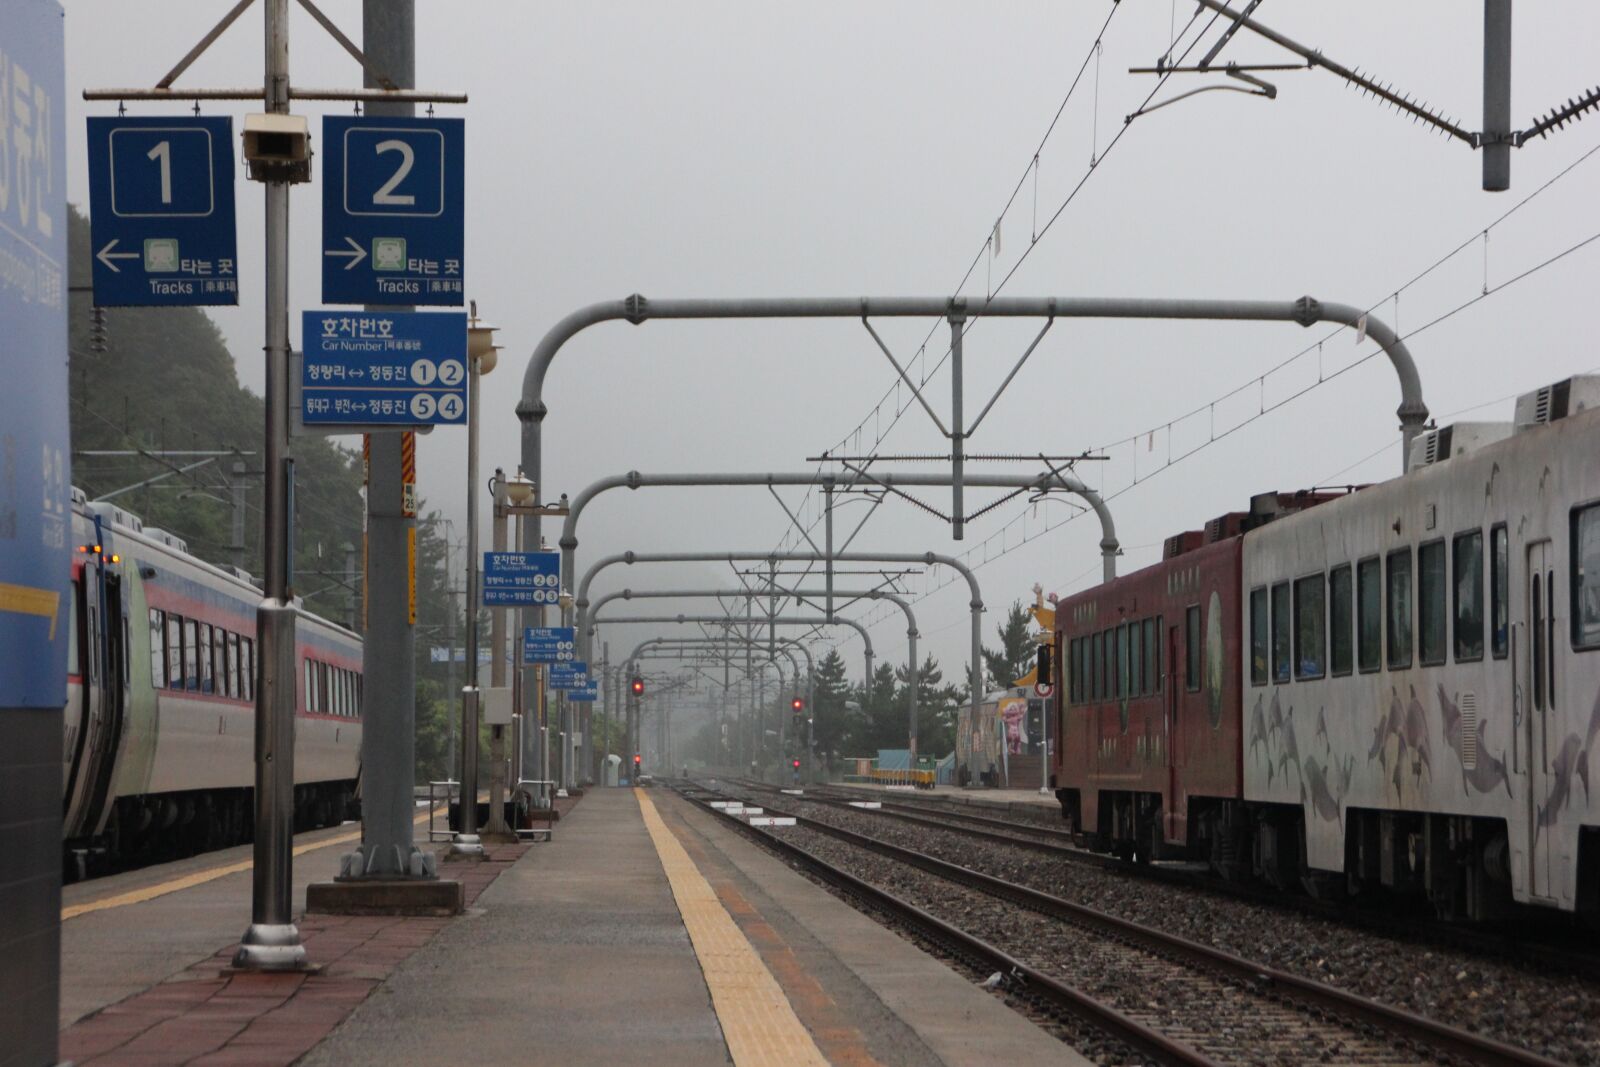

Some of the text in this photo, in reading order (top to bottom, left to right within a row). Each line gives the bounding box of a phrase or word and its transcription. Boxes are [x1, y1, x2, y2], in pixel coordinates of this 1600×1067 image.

[147, 141, 172, 204] 1
[372, 139, 415, 205] 2
[181, 258, 233, 275] 타는 곳
[408, 258, 460, 275] 타는 곳
[149, 280, 193, 294] Tracks
[376, 279, 419, 293] Tracks
[321, 317, 393, 338] 호차번호
[322, 340, 382, 351] Car Number
[308, 364, 345, 380] 청량리
[369, 365, 406, 381] 정동진
[445, 364, 457, 381] 2
[306, 398, 458, 415] 동대구 부전 정동진 5 4
